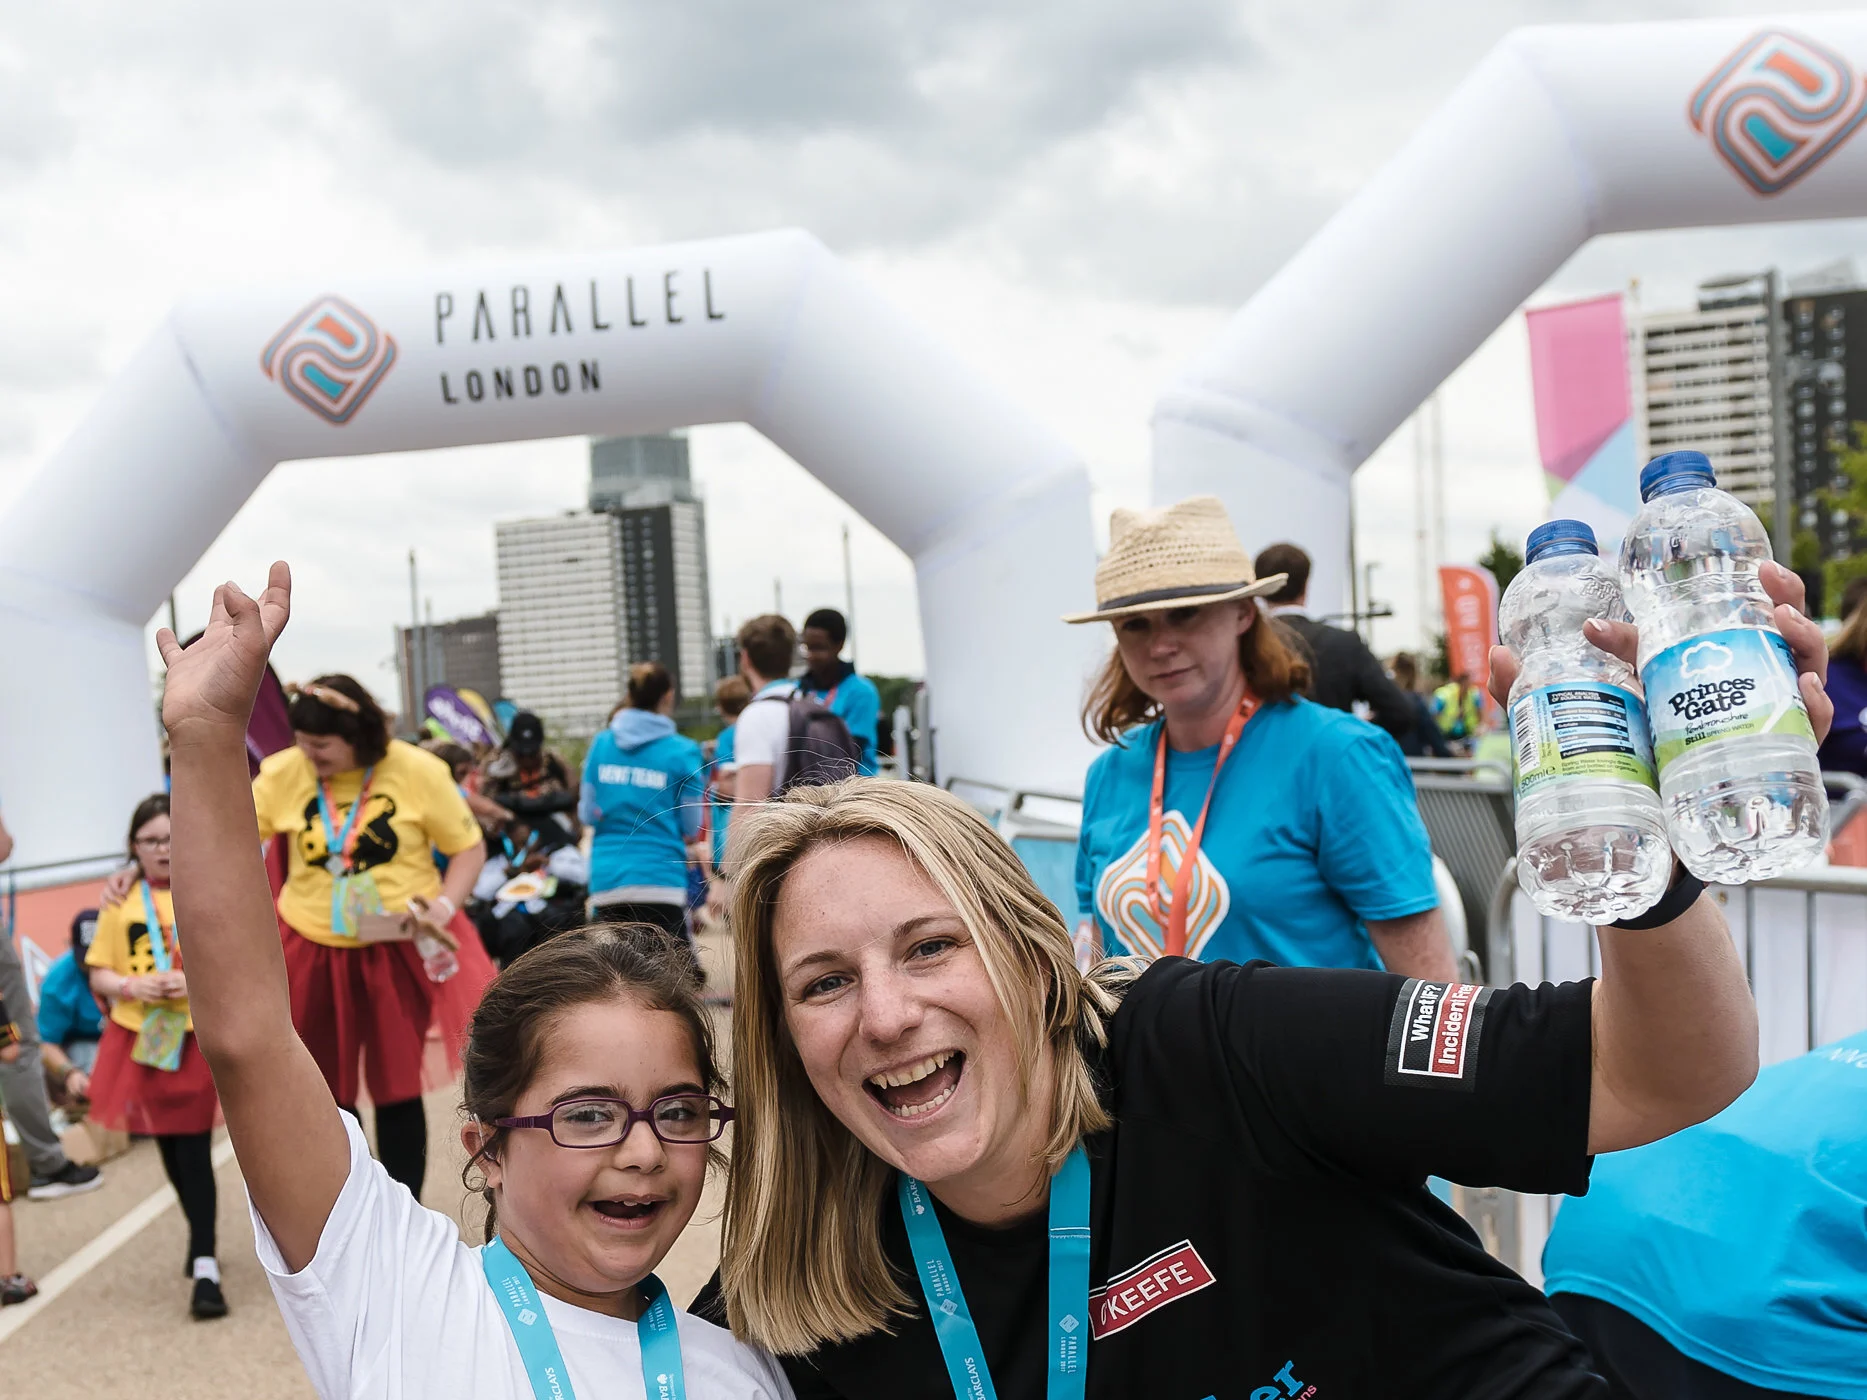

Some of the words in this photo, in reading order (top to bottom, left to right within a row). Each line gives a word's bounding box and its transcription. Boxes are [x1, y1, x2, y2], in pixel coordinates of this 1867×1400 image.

[435, 268, 725, 345] PARALLEL
[440, 358, 602, 406] LONDON
[1668, 677, 1756, 716] Princes
[1684, 689, 1747, 721] Gate
[1685, 732, 1706, 745] Still
[500, 1277, 523, 1309] PARALLEL
[927, 1259, 945, 1298] PARALLEL
[1068, 1336, 1077, 1375] PARALLEL
